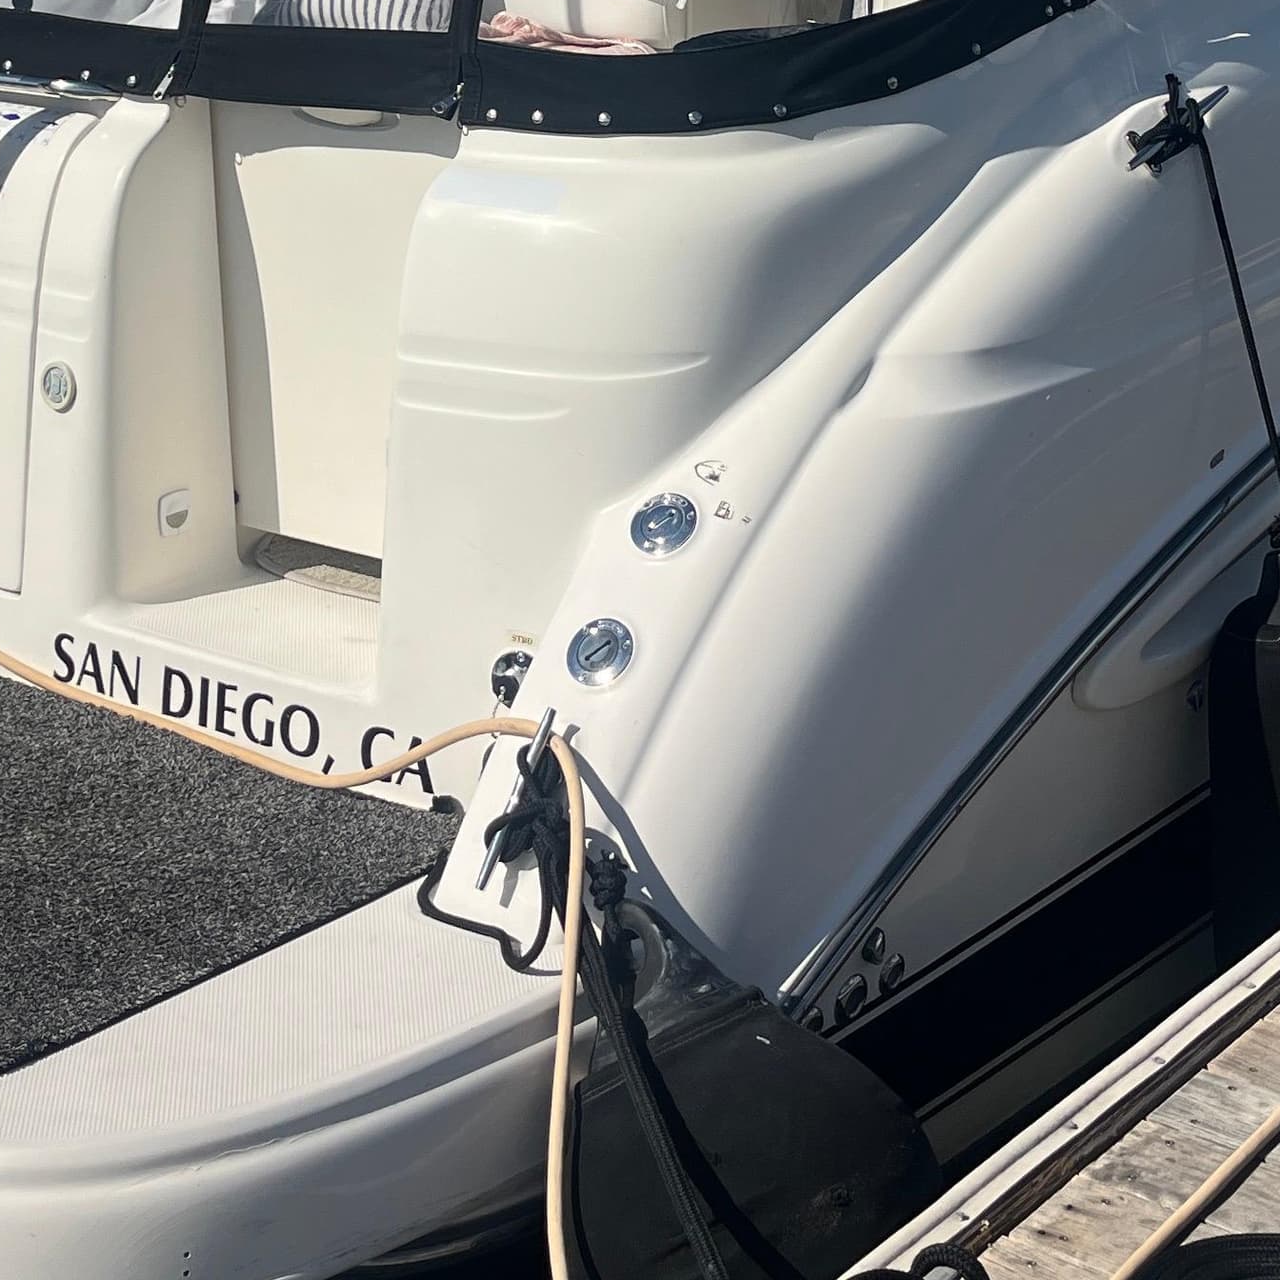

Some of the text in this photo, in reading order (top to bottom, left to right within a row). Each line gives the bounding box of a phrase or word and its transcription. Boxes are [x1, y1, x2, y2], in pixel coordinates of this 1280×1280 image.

[53, 633, 435, 795] SAN DIEGO, CA
